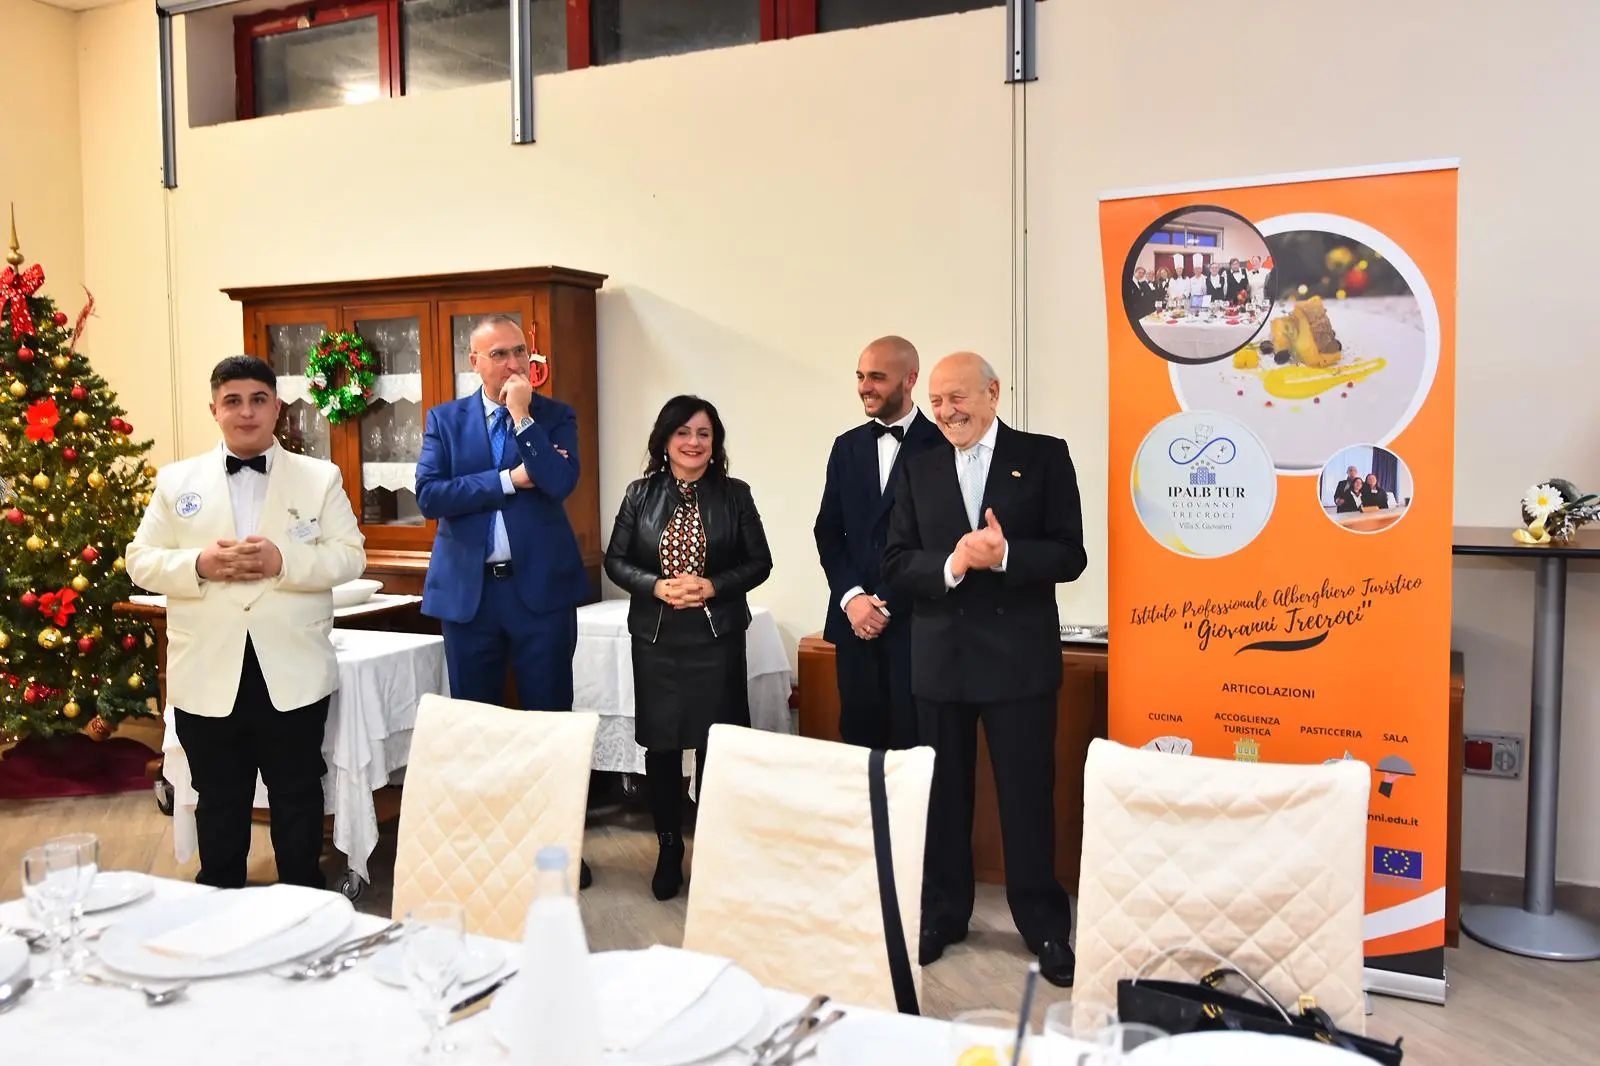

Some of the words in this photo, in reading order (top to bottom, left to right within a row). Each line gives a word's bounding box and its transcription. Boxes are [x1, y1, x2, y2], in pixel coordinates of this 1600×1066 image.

[1168, 486, 1211, 498] IPALB
[1215, 486, 1245, 498] TUR
[1172, 501, 1234, 509] GIOVANNI
[1130, 603, 1177, 625] Istituto
[1182, 590, 1268, 618] Professionale
[1273, 578, 1355, 608] Alberghiero
[1361, 574, 1422, 597] Turistico
[1222, 683, 1315, 699] ARTICOLAZIONI
[1148, 712, 1183, 723] CUCINA
[1214, 712, 1280, 725] ACCOGLIENZA
[1223, 724, 1271, 737] TURISTICA
[1300, 725, 1363, 739] PASTICCERIA
[1383, 733, 1409, 744] SALA
